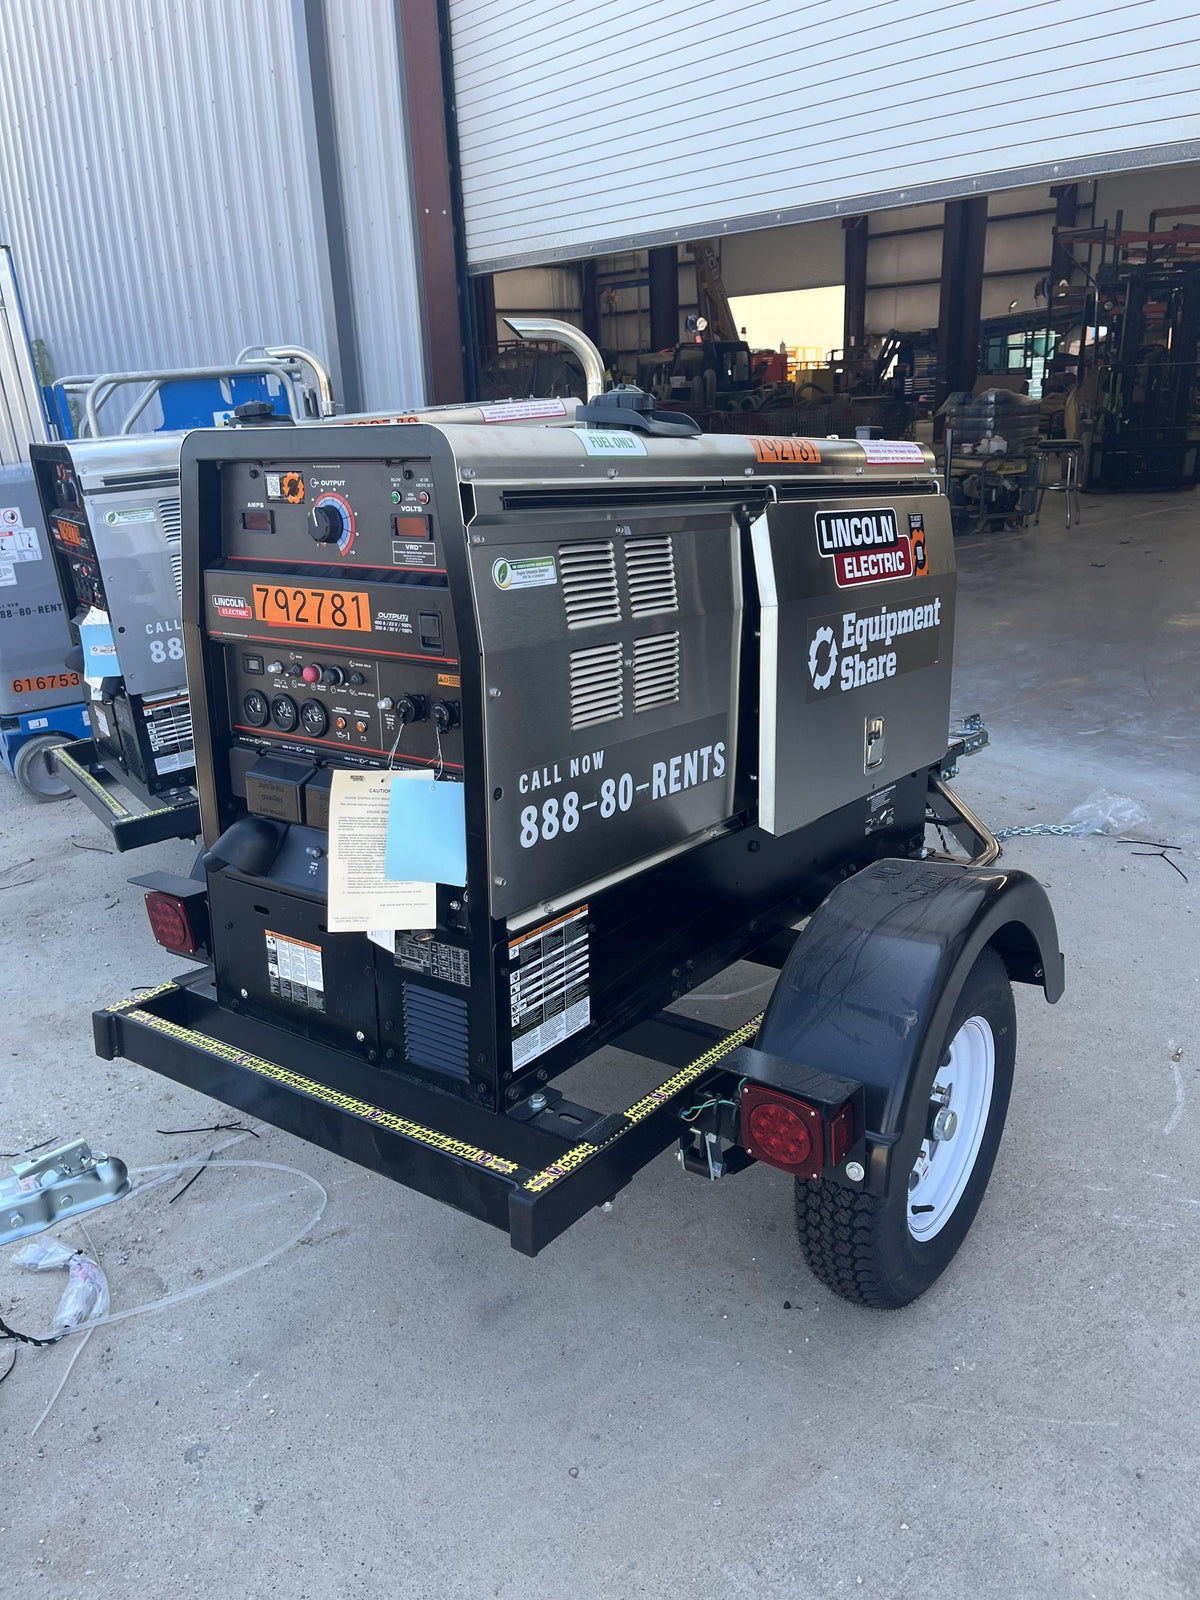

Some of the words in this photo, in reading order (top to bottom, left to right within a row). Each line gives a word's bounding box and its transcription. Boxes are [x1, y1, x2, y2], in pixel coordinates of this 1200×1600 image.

[588, 436, 615, 449] FUEL
[612, 436, 637, 449] ONLY
[751, 438, 819, 462] 792781
[820, 515, 895, 549] LINCOLN
[843, 551, 906, 579] ELECTRIC
[214, 597, 245, 608] LINCOLN
[222, 608, 249, 617] ELECTRIC
[256, 587, 362, 628] 792781
[145, 620, 181, 635] CALL
[841, 597, 941, 652] Equipment
[13, 673, 80, 693] 616753
[840, 652, 897, 691] Share
[519, 764, 562, 794] CALL
[570, 750, 604, 779] NOW
[519, 741, 726, 849] 888-80-RENTS
[154, 1021, 167, 1029] DO
[169, 1027, 187, 1035] NOT
[184, 1034, 214, 1048] STAND
[212, 1043, 239, 1057] HERE
[247, 1060, 262, 1069] NE
[260, 1066, 281, 1076] PAS
[280, 1073, 313, 1089] TENEZ
[310, 1086, 352, 1106] DEBOUT
[351, 1104, 370, 1113] ICI
[675, 1072, 692, 1086] PAS
[630, 1099, 656, 1117] HERE
[381, 1116, 399, 1126] NO
[399, 1123, 417, 1132] SE
[415, 1130, 446, 1146] PARE
[446, 1142, 478, 1158] AQUI
